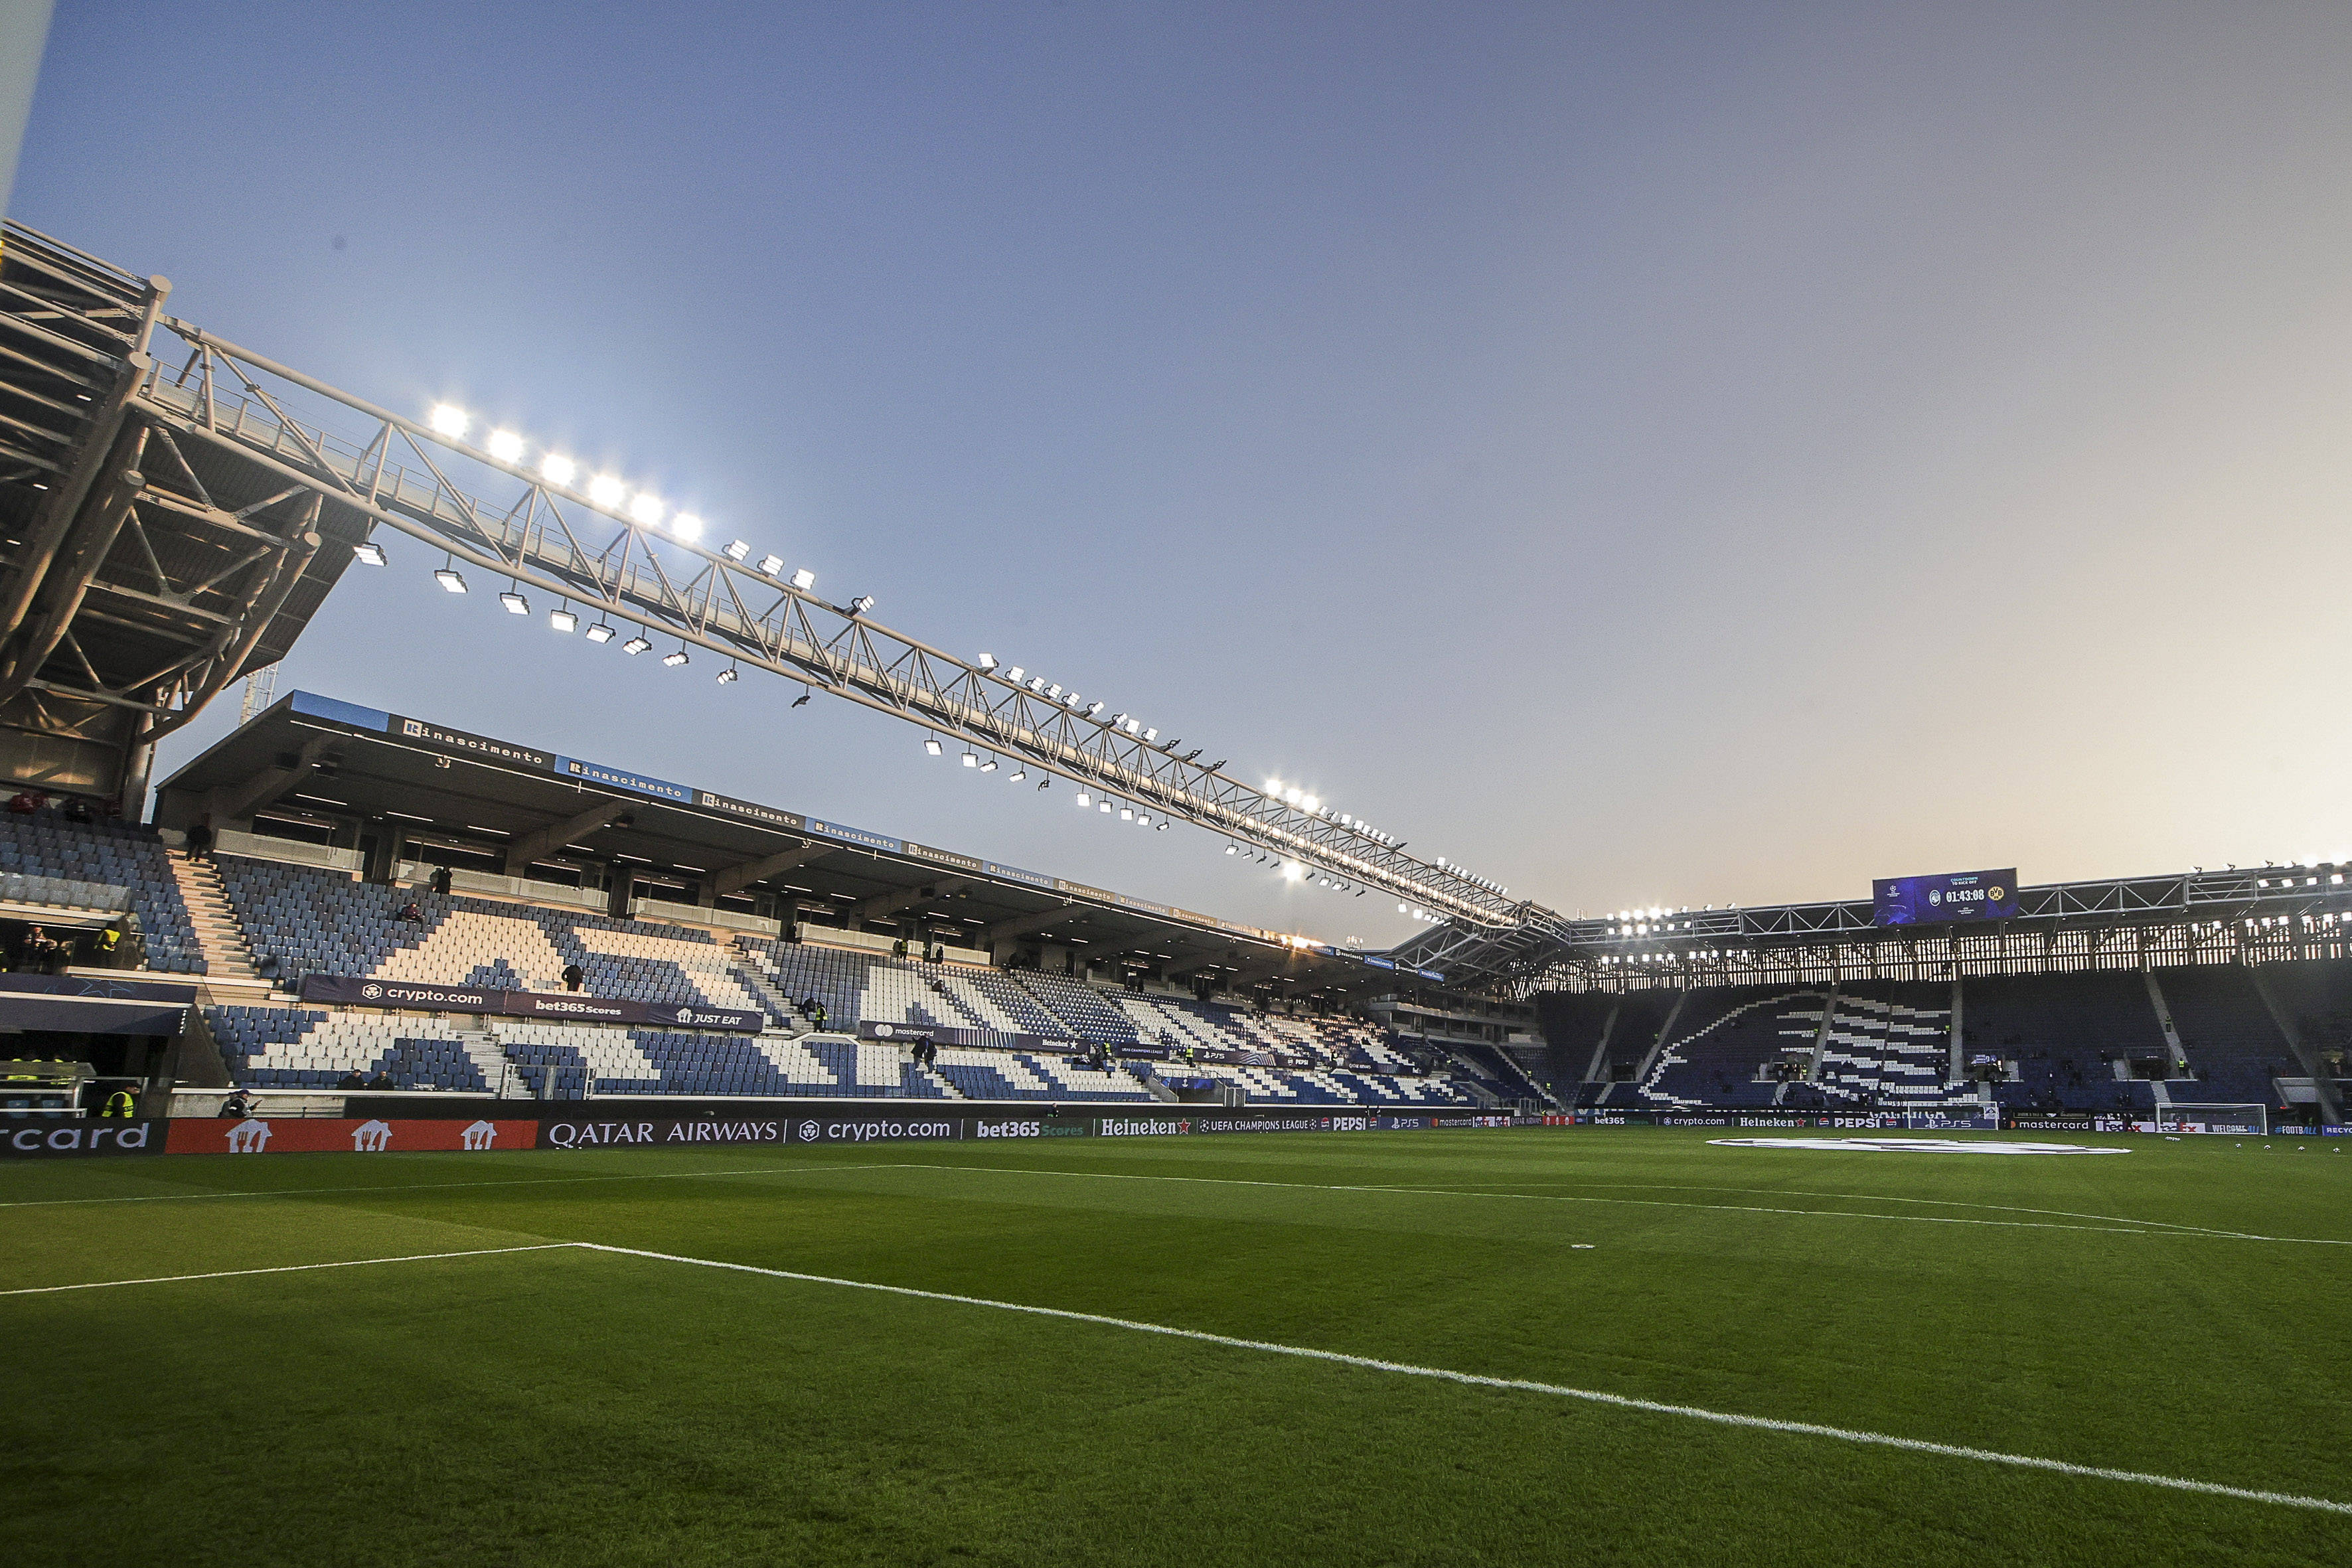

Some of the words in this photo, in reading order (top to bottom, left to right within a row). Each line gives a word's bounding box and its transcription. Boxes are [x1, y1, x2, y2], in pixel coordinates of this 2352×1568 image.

[403, 719, 543, 764] Rinascimento
[569, 761, 682, 798] Rinascimento
[702, 793, 797, 825] Rinascimento
[815, 822, 895, 848] Rinascimento
[909, 844, 977, 868] Rinascimento
[990, 864, 1048, 885] Rinascimento
[1990, 888, 2002, 897] BVB
[387, 988, 483, 1004] crypto.com
[694, 1014, 721, 1024] JUST
[722, 1015, 742, 1026] EAT
[977, 1121, 1040, 1137] bet365
[1101, 1119, 1176, 1136] Heineken
[1211, 1122, 1233, 1131] UEFA
[1235, 1121, 1280, 1131] CHAMPIONS
[1282, 1120, 1308, 1129] LEAGUE
[1333, 1117, 1366, 1131] PEPSI
[1439, 1117, 1472, 1127] mastercard
[1674, 1117, 1725, 1126] crypto.com
[1740, 1117, 1794, 1127] Heineken
[1834, 1117, 1881, 1128] PEPSI
[2019, 1121, 2089, 1129] mastercard
[549, 1123, 654, 1148] QATAR
[666, 1122, 777, 1141] AIRWAYS
[828, 1121, 950, 1141] crypto.com
